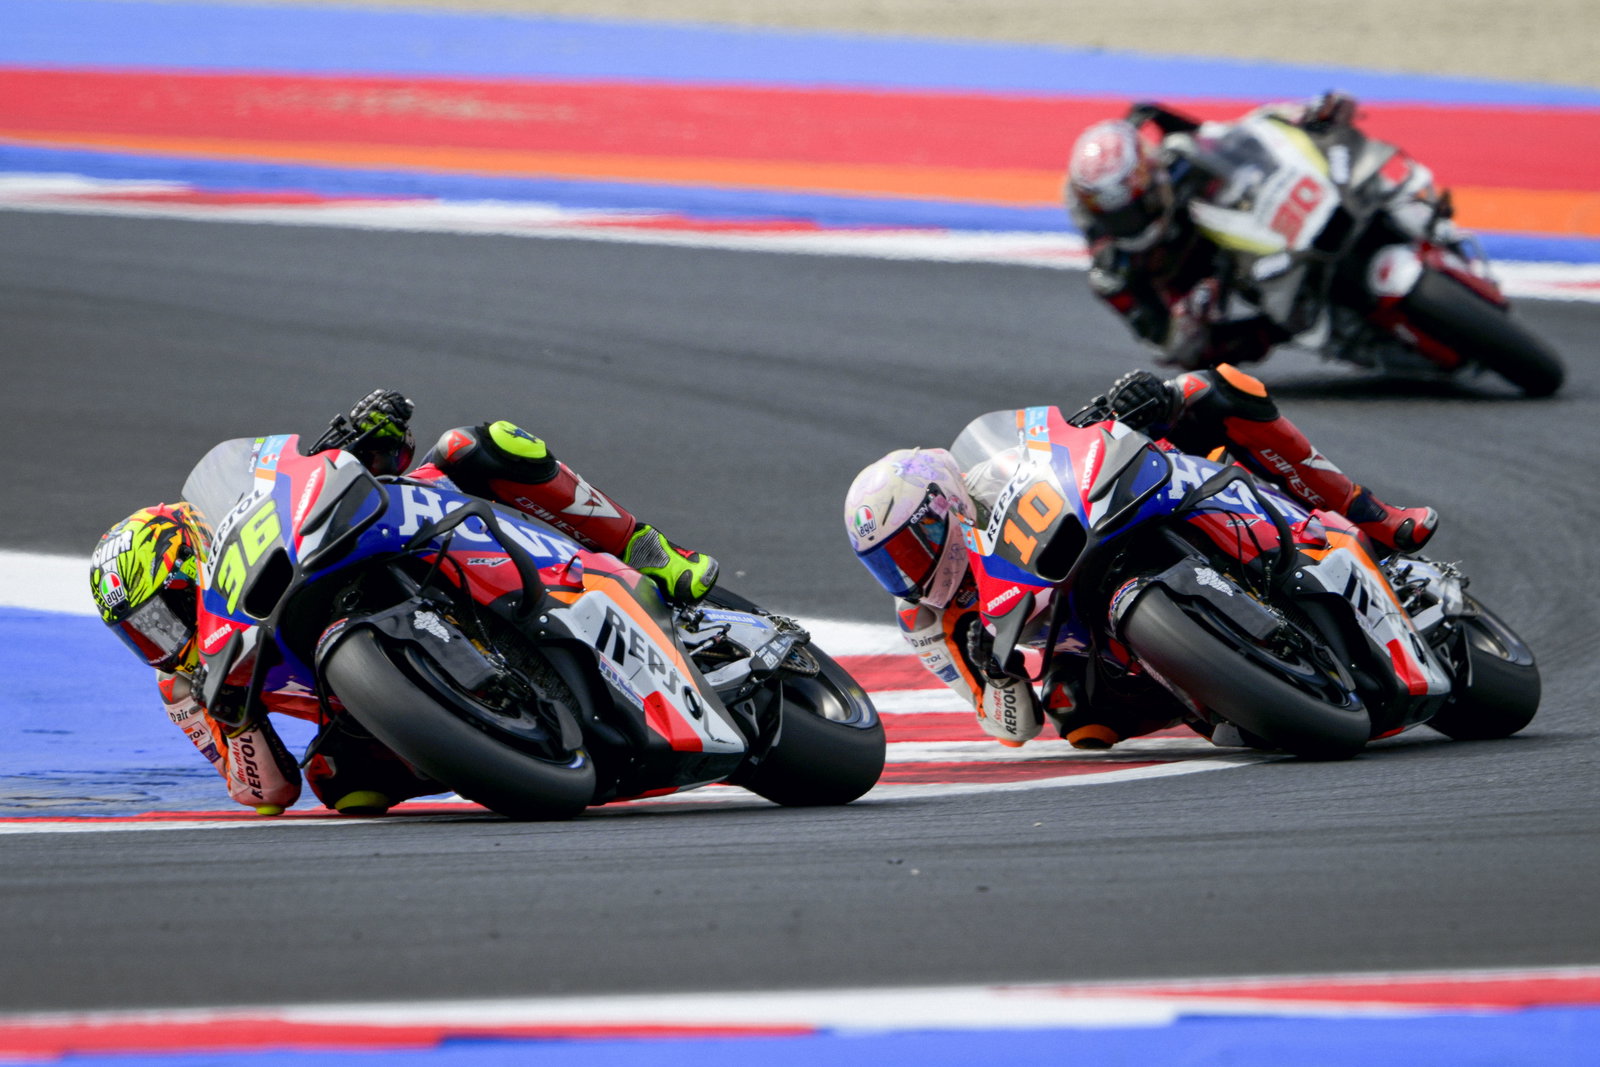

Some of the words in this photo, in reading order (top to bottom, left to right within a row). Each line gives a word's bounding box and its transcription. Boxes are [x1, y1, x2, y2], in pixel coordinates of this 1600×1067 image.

[1082, 439, 1100, 490] HONDA
[1003, 480, 1064, 566] 10
[217, 500, 281, 616] 36
[987, 586, 1021, 612] HONDA
[203, 623, 232, 649] HONDA
[595, 606, 735, 745] REPSOL
[1003, 687, 1017, 735] REPSOL
[240, 735, 264, 800] REPSOL
